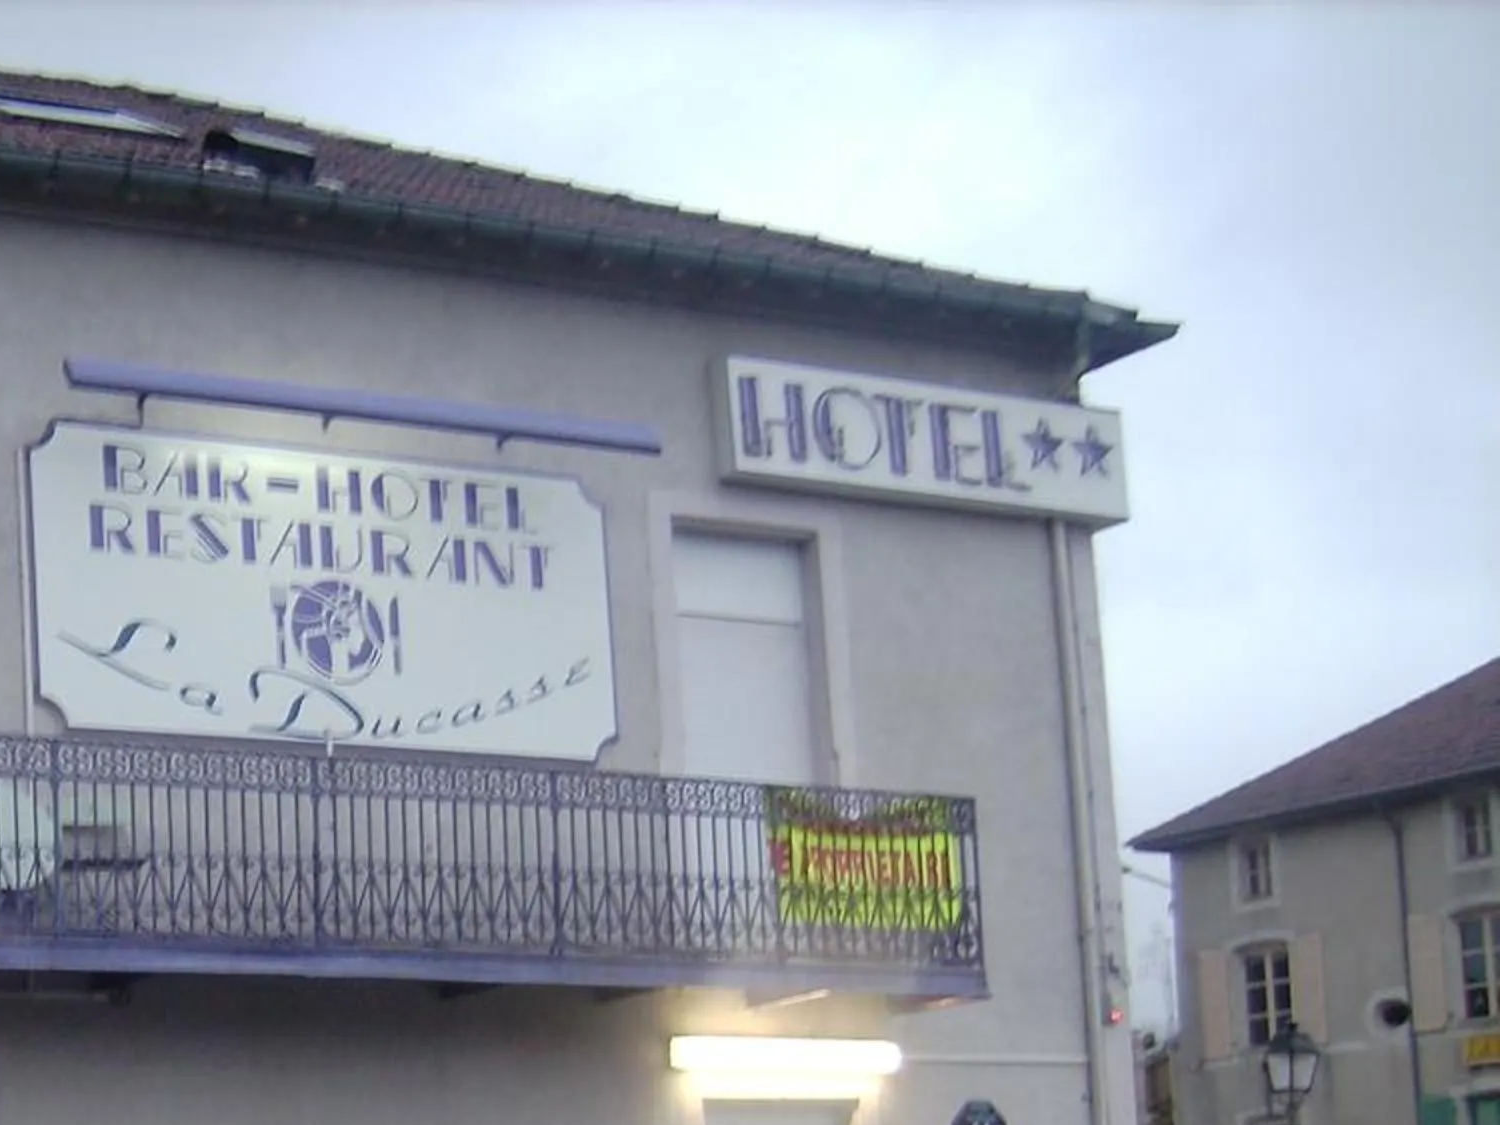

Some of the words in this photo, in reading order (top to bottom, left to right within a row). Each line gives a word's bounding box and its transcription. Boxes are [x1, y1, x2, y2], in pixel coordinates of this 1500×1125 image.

[737, 375, 1032, 492] HOTEL
[89, 502, 557, 591] RESTAURANT
[56, 616, 224, 716] La
[246, 656, 592, 741] Ducasse
